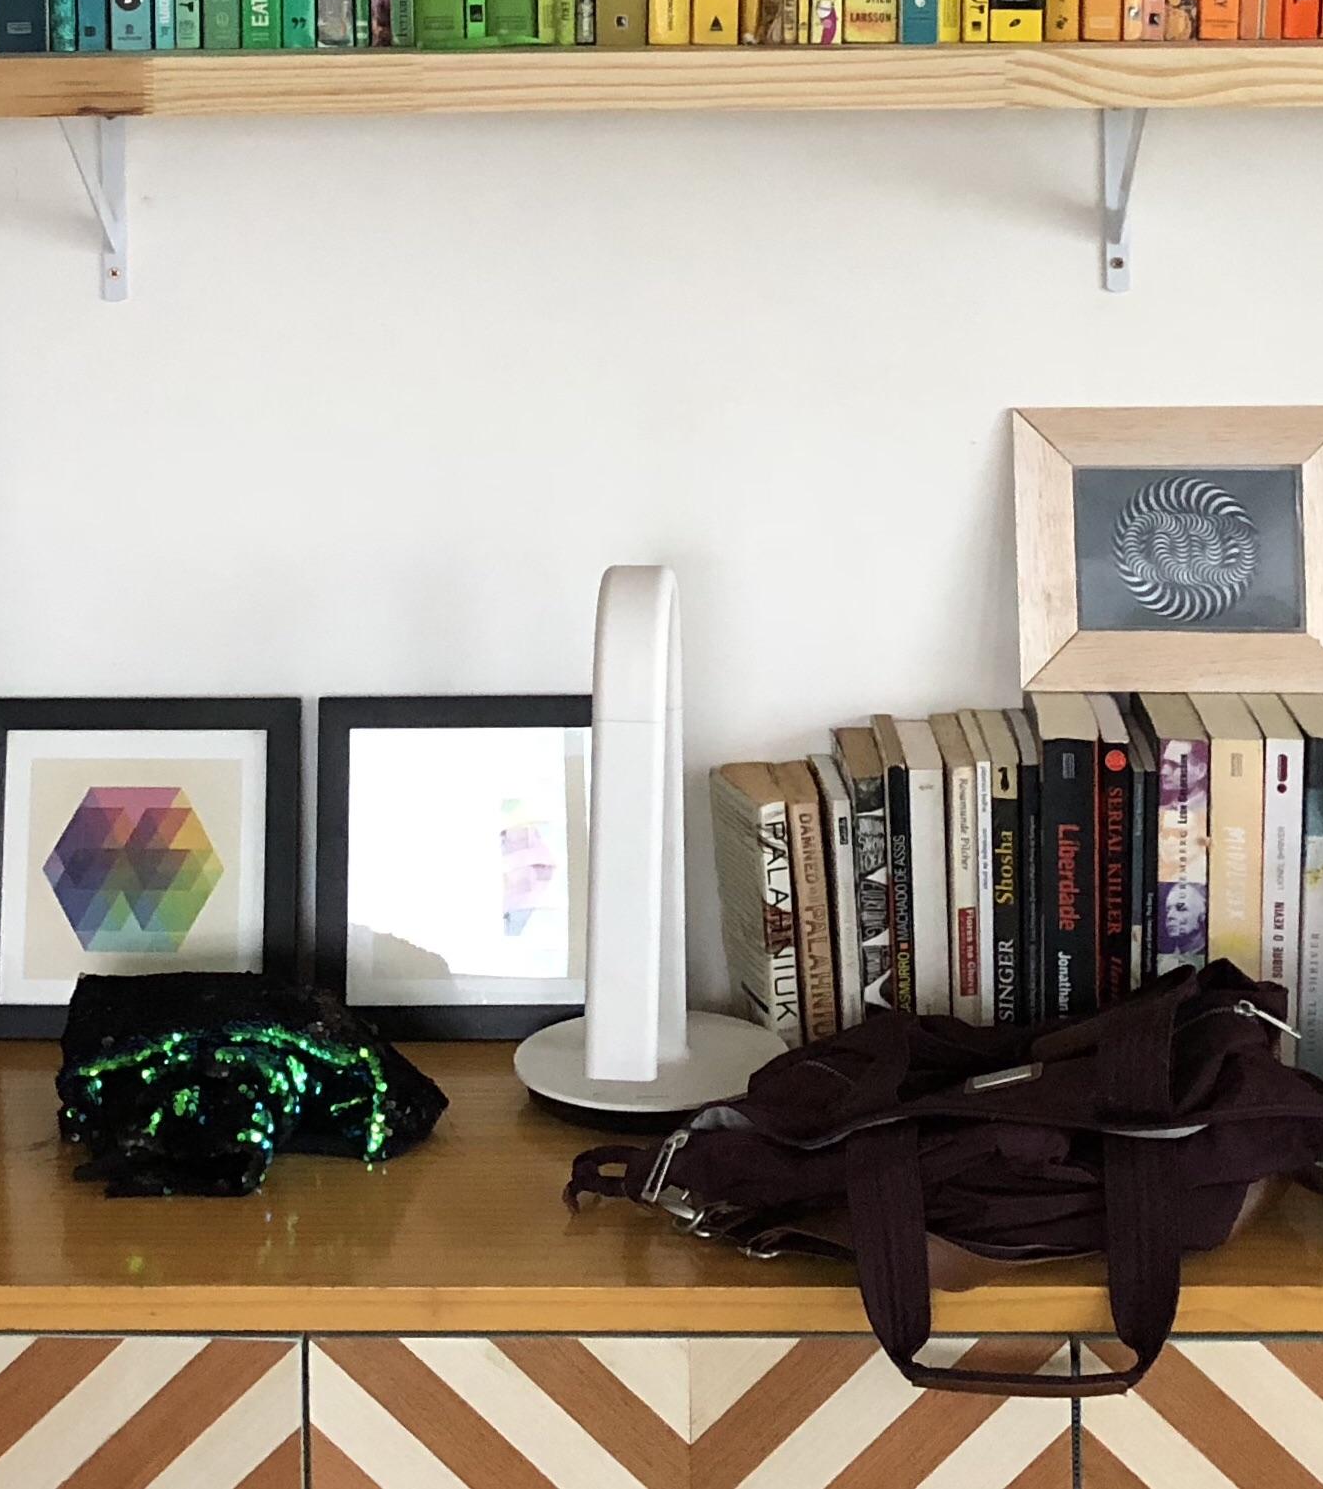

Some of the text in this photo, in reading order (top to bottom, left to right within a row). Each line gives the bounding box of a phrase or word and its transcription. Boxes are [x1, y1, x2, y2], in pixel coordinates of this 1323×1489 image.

[850, 12, 892, 23] LARSSON
[798, 813, 819, 885] DAMNED
[958, 778, 971, 834] Rosamunde
[892, 834, 910, 942] MACHADO DE ASSIS
[1107, 786, 1124, 936] SERIAL KILLER
[764, 820, 798, 1022] PALAHNIUK
[995, 831, 1016, 1023] SINGER Shosha
[1056, 823, 1081, 1011] Liberdade Jonathan
[1272, 902, 1286, 979] SOBRE KEVIN
